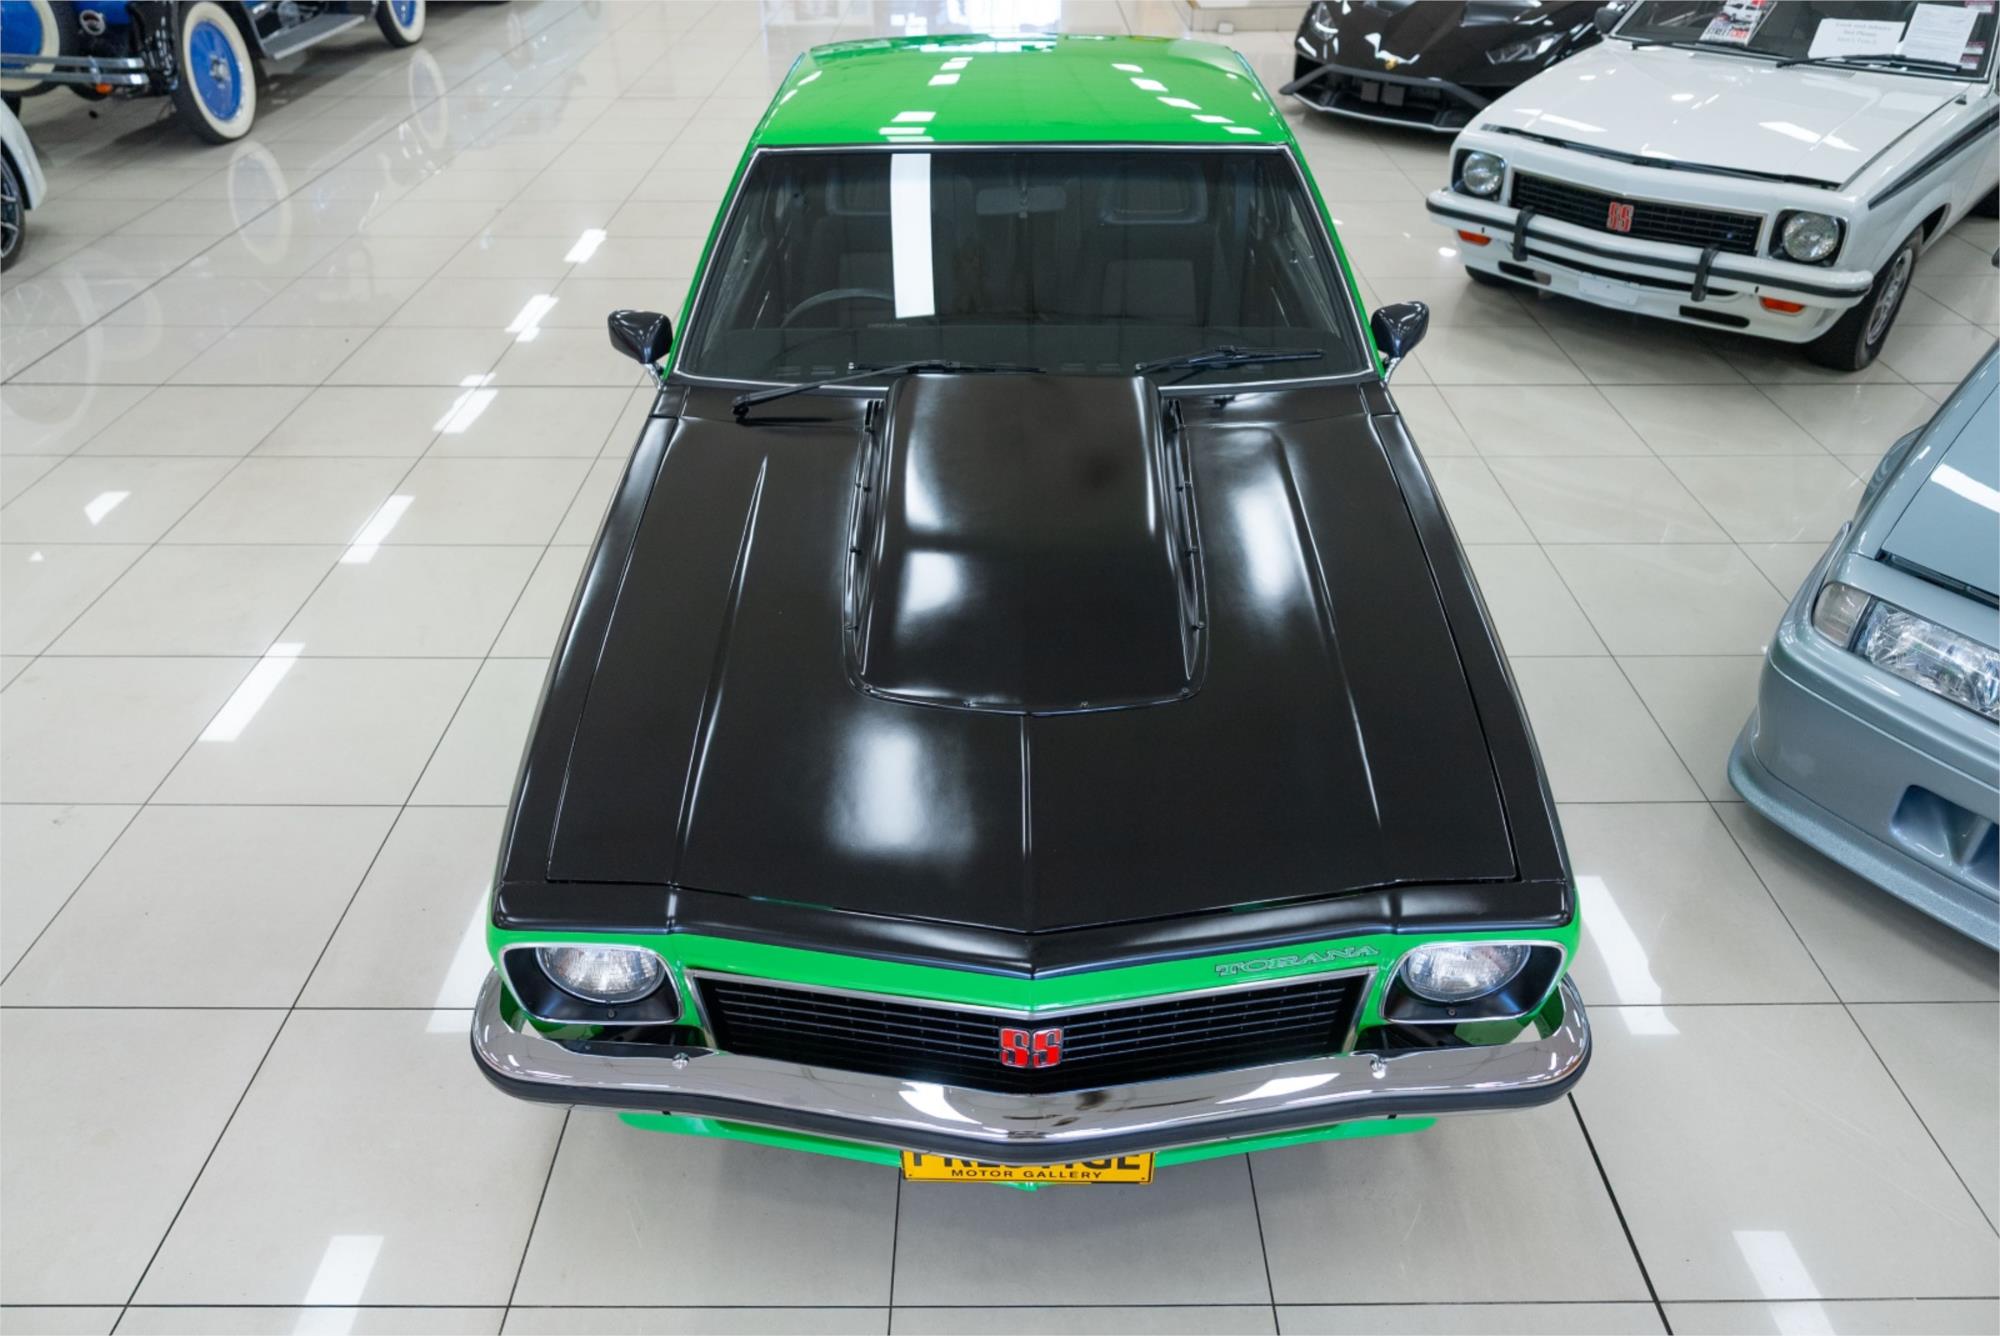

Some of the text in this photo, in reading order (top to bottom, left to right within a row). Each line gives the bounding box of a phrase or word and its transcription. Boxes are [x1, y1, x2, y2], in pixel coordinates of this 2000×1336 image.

[1215, 945, 1379, 977] TORANA
[1000, 1027, 1063, 1069] SS
[951, 1169, 1102, 1179] MOTOR GALLERY
